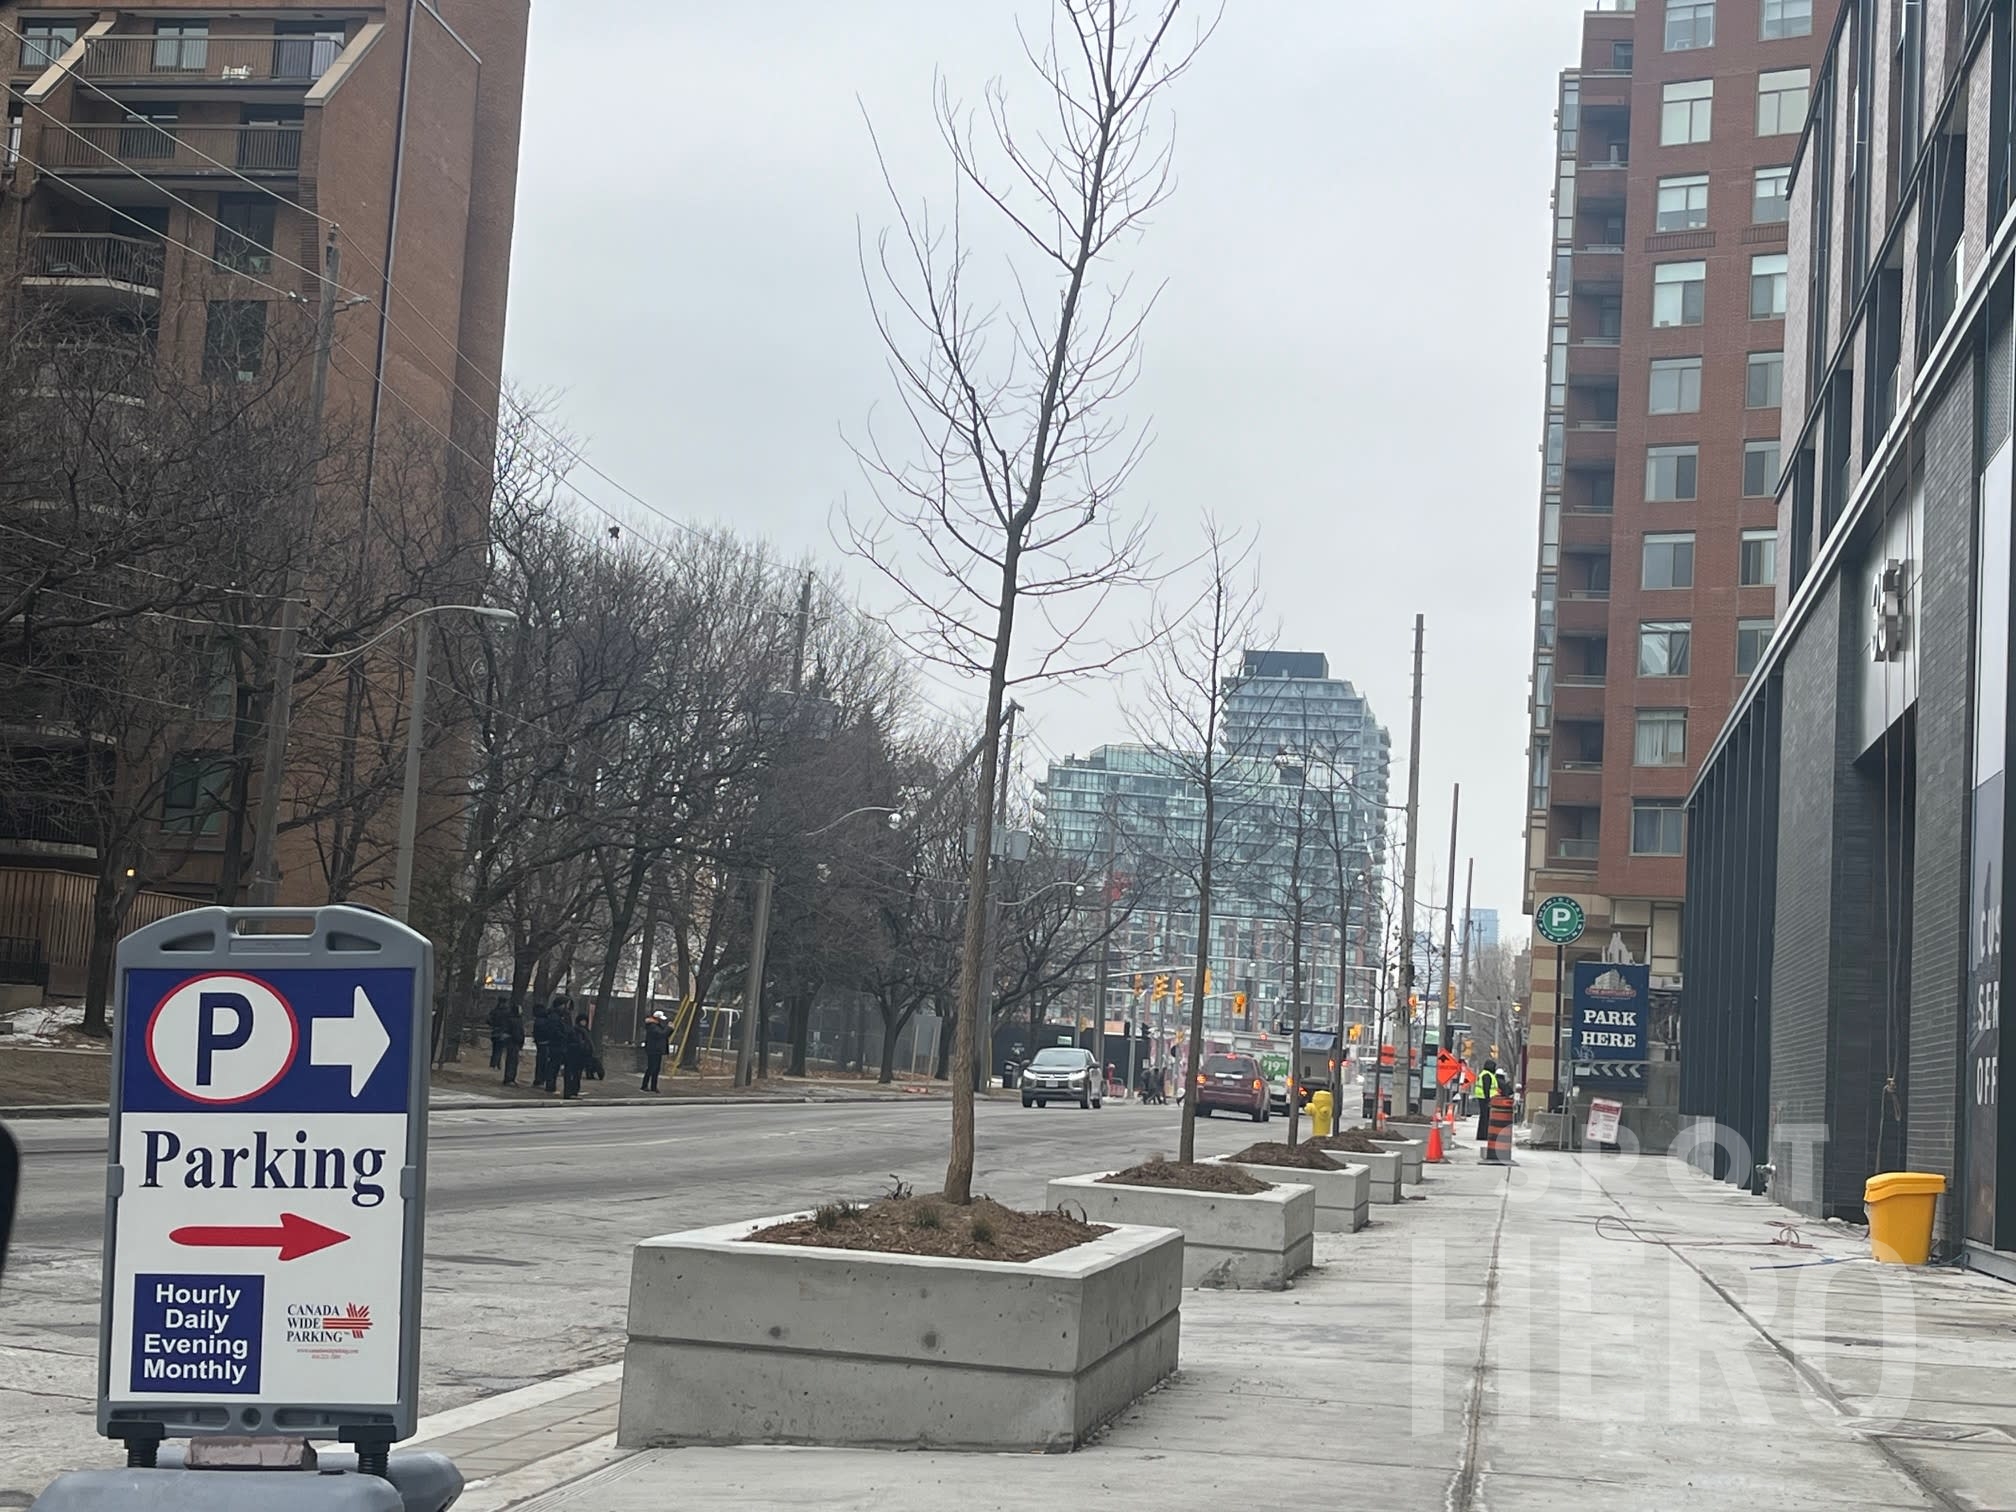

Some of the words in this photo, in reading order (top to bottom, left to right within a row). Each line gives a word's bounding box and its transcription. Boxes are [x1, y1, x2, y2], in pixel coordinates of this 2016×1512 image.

[1552, 907, 1571, 927] P
[1583, 1009, 1637, 1026] PARK
[196, 991, 254, 1087] P
[1581, 1031, 1636, 1048] HERE
[1976, 1056, 1998, 1105] OFF
[138, 1129, 387, 1208] Parking
[155, 1283, 241, 1310] Hourly
[165, 1309, 230, 1334] Daily
[287, 1303, 340, 1316] CANADA
[287, 1317, 320, 1329] WIDE
[144, 1333, 248, 1360] Evening
[286, 1330, 343, 1343] PARKING
[143, 1358, 247, 1385] Monthly
